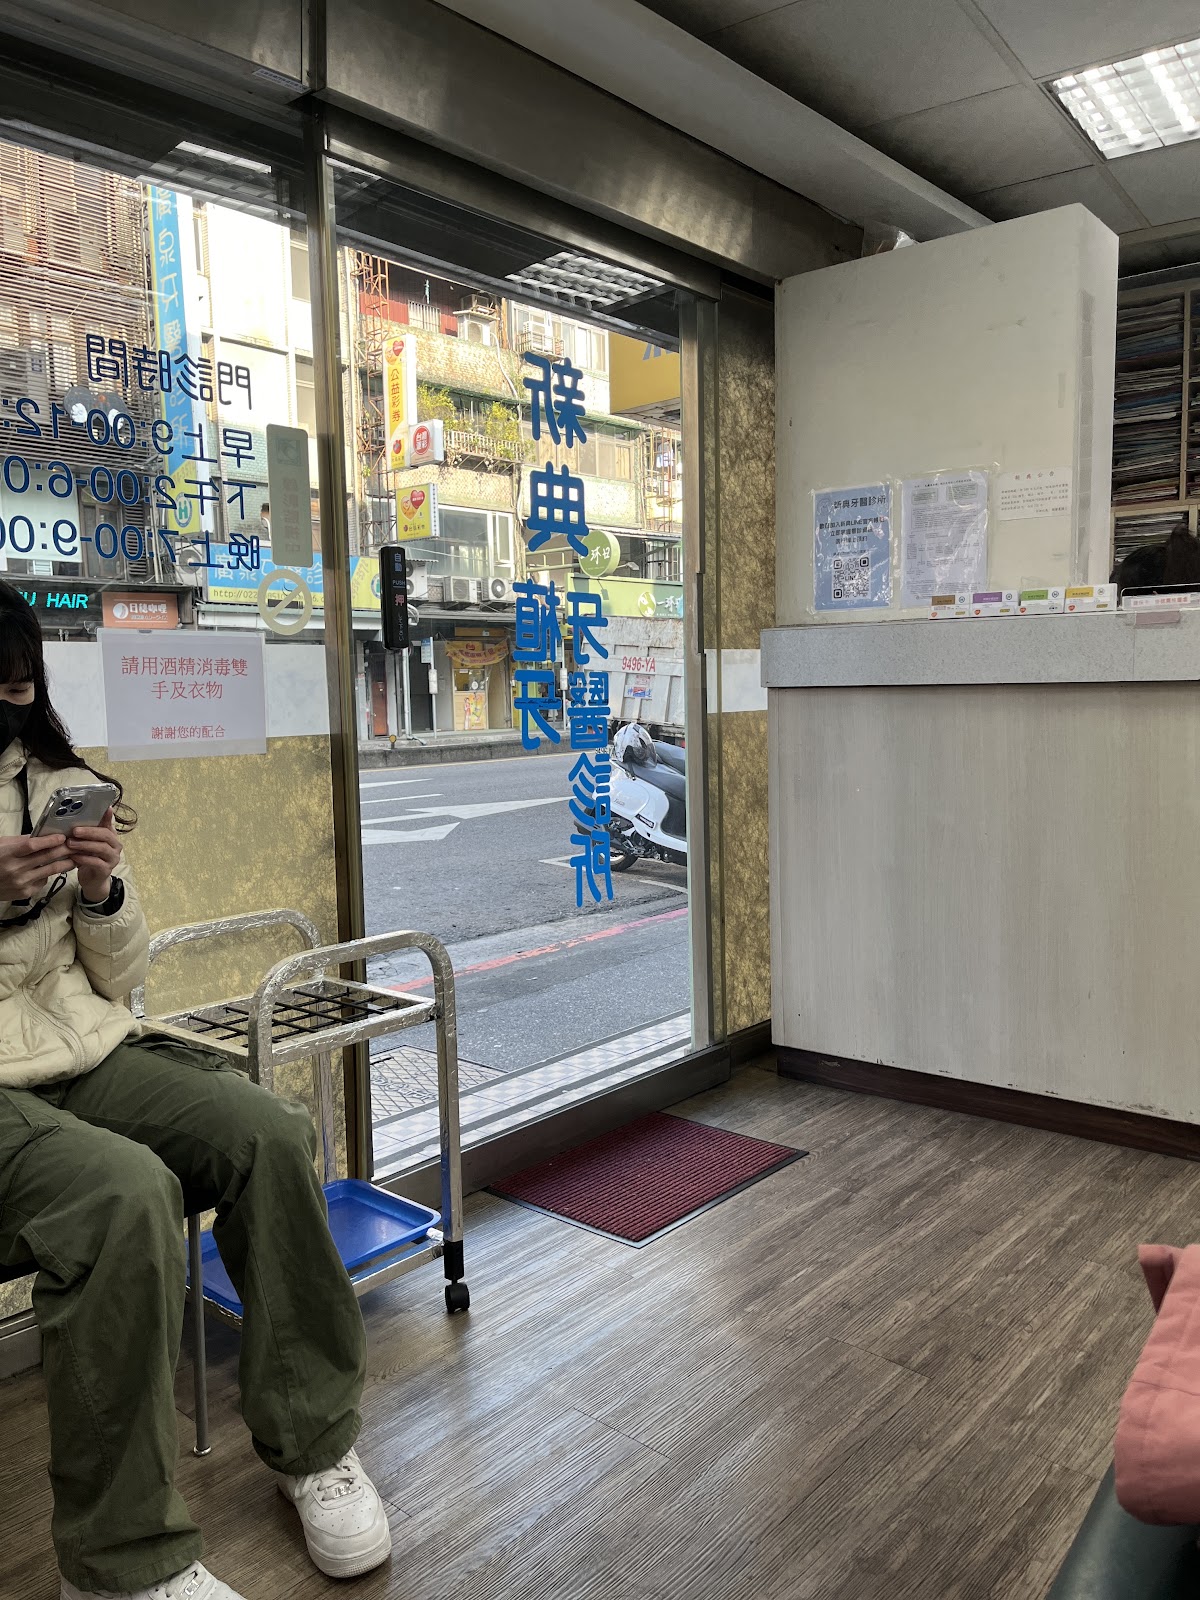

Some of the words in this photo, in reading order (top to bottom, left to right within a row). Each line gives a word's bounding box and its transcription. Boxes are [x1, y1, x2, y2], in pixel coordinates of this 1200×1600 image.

[834, 495, 886, 510] 新典牙醫診所
[46, 592, 89, 609] HAIR
[394, 593, 405, 607] 押
[121, 656, 249, 677] 請用酒精消毒雙
[621, 655, 656, 673] 9496-YA
[151, 680, 224, 700] 手及衣物
[151, 724, 225, 740] 謝謝您的配合
